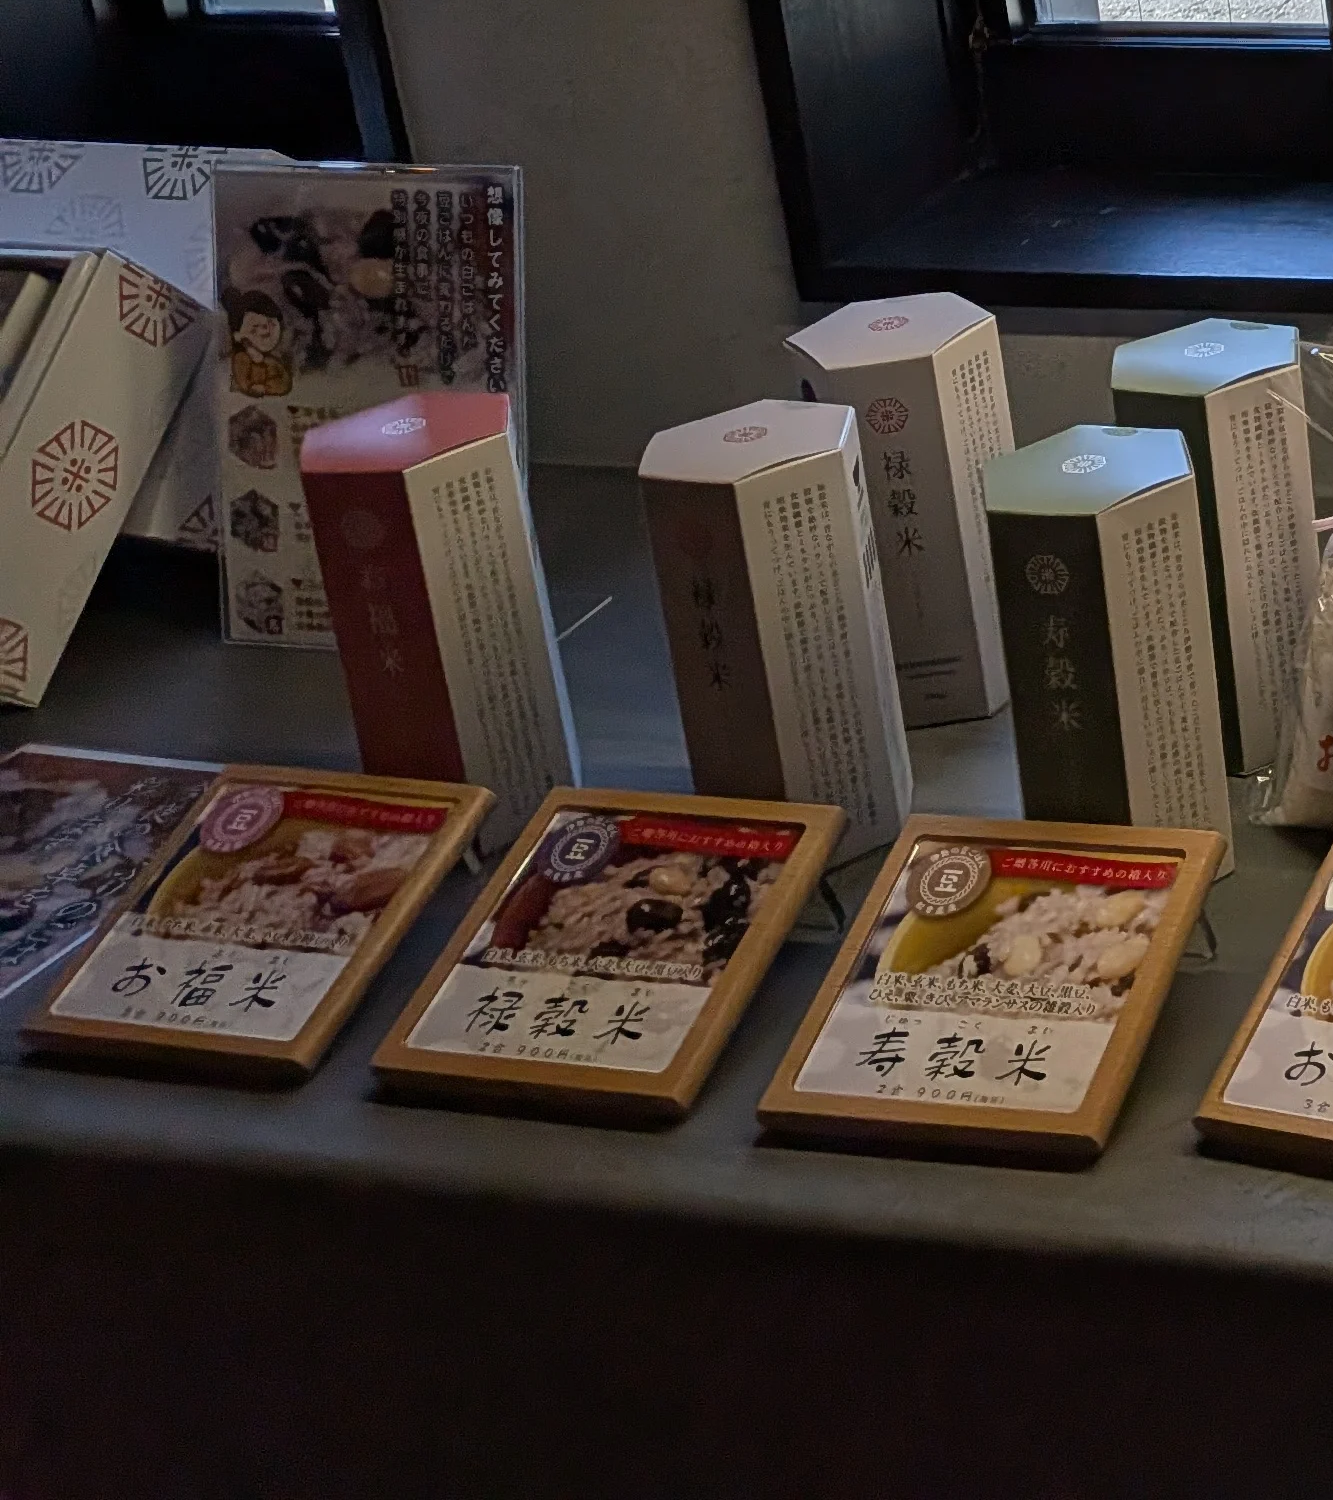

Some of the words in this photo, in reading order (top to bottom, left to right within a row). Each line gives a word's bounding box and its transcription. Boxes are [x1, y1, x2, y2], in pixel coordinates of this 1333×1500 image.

[485, 185, 506, 393] 想像してみてください
[934, 869, 963, 892] 豆
[1000, 855, 1170, 882] ご贈答用におすすめの箱入り
[112, 956, 287, 1013] お福米
[465, 986, 652, 1046] 禄穀米
[856, 1027, 1052, 1087] 寿穀米
